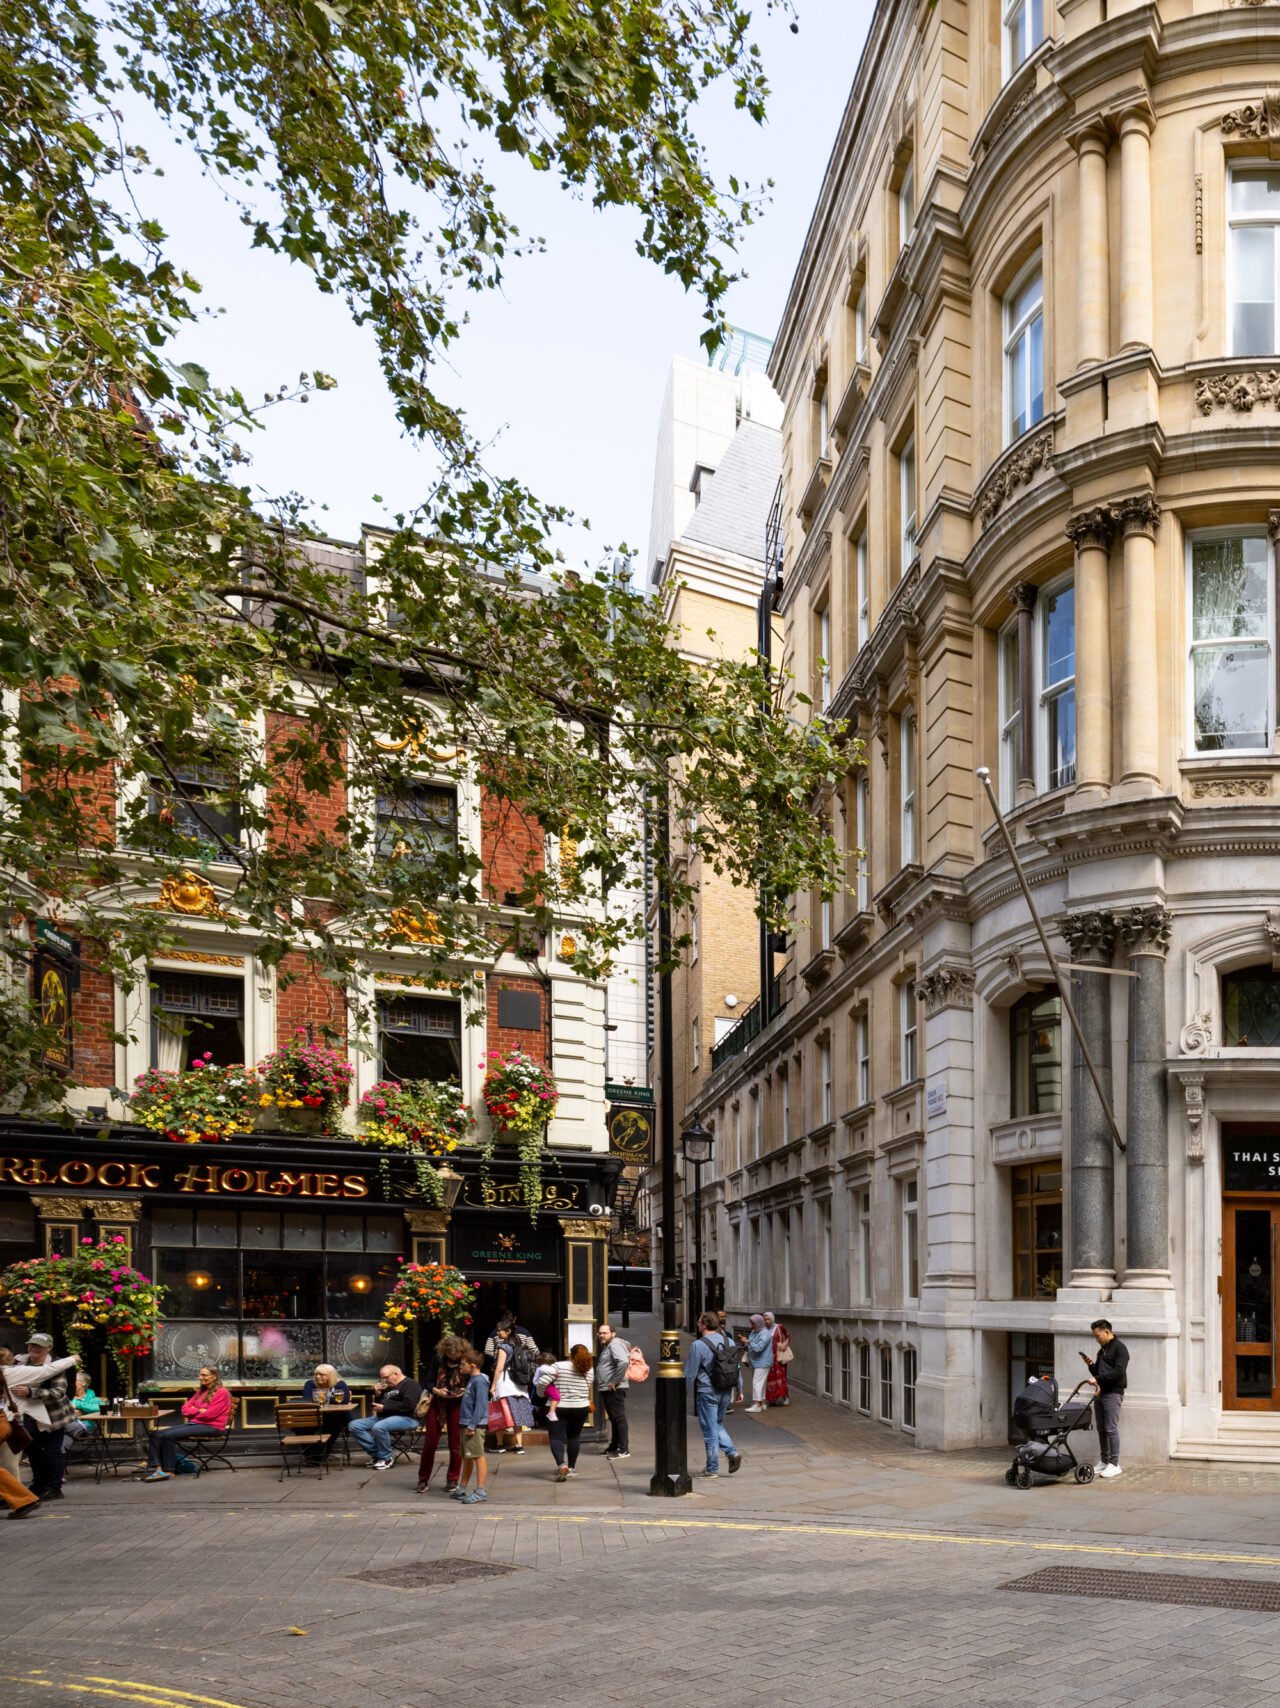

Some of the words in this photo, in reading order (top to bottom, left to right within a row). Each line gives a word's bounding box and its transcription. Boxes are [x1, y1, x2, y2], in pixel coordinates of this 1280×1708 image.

[607, 1087, 633, 1096] GREENE
[611, 1150, 649, 1159] SHERLOCK
[1233, 1152, 1268, 1162] THAI
[174, 1164, 369, 1198] HOLMES
[471, 1250, 513, 1260] GREENE
[515, 1251, 542, 1261] KING
